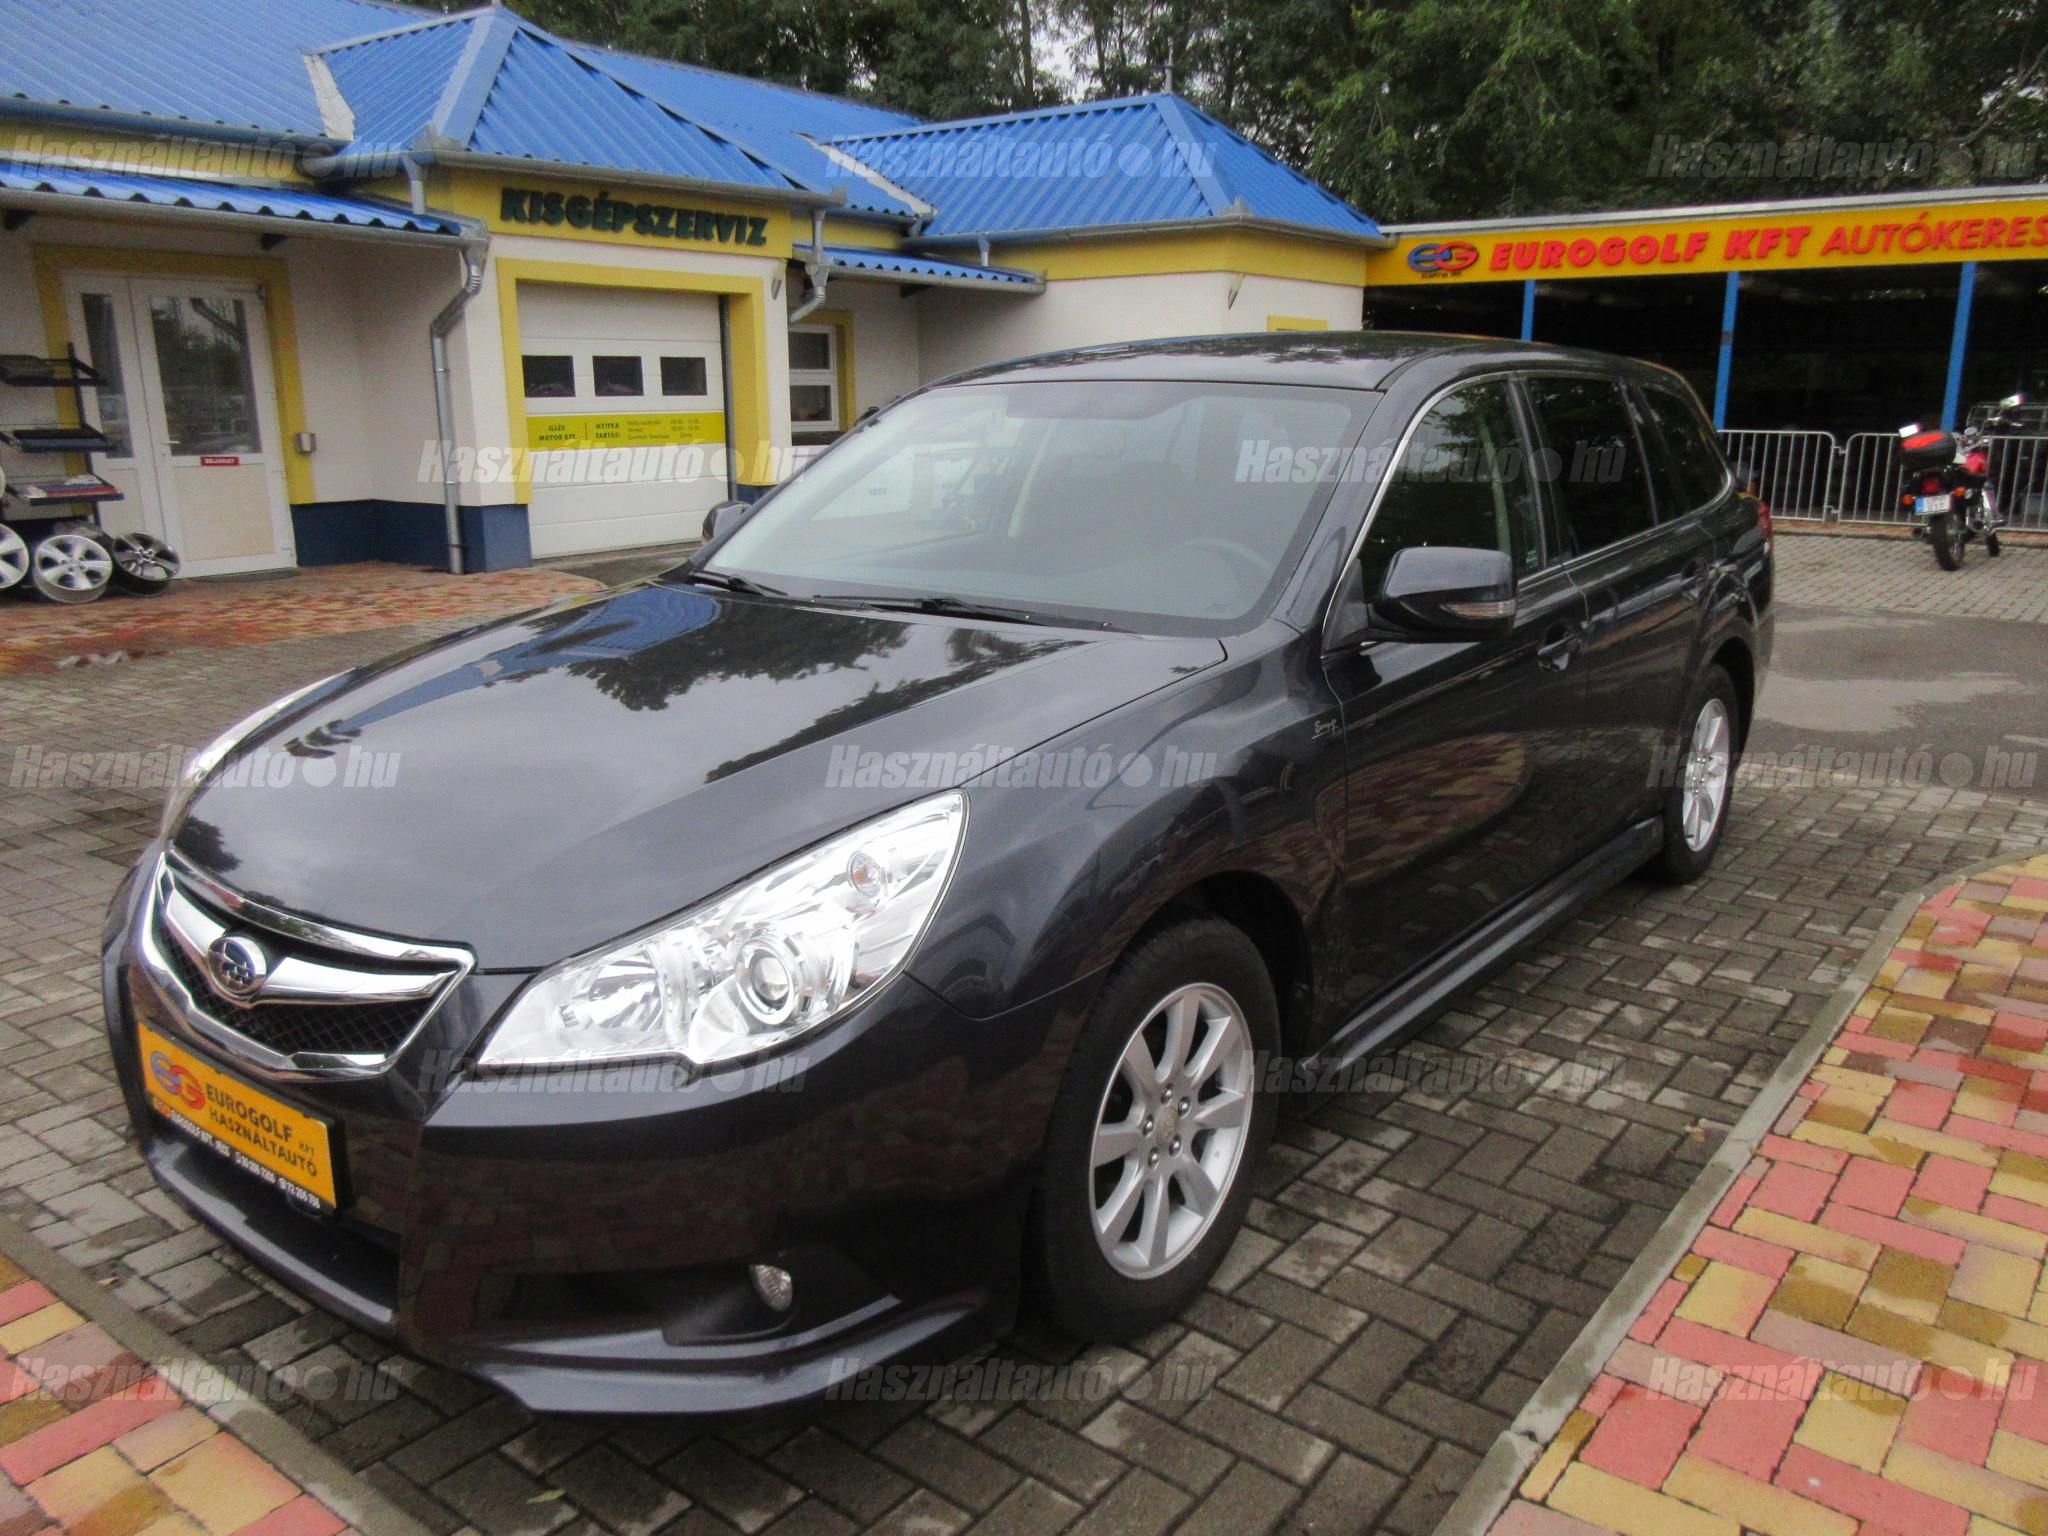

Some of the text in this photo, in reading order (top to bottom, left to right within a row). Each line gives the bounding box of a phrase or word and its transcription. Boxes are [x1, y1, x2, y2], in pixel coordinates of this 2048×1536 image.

[500, 187, 769, 247] KISGÉPSZERVIZ
[1489, 231, 1708, 271] EUROGOLF
[1723, 226, 1812, 261] KFT
[206, 1084, 292, 1143] EUROGOLF
